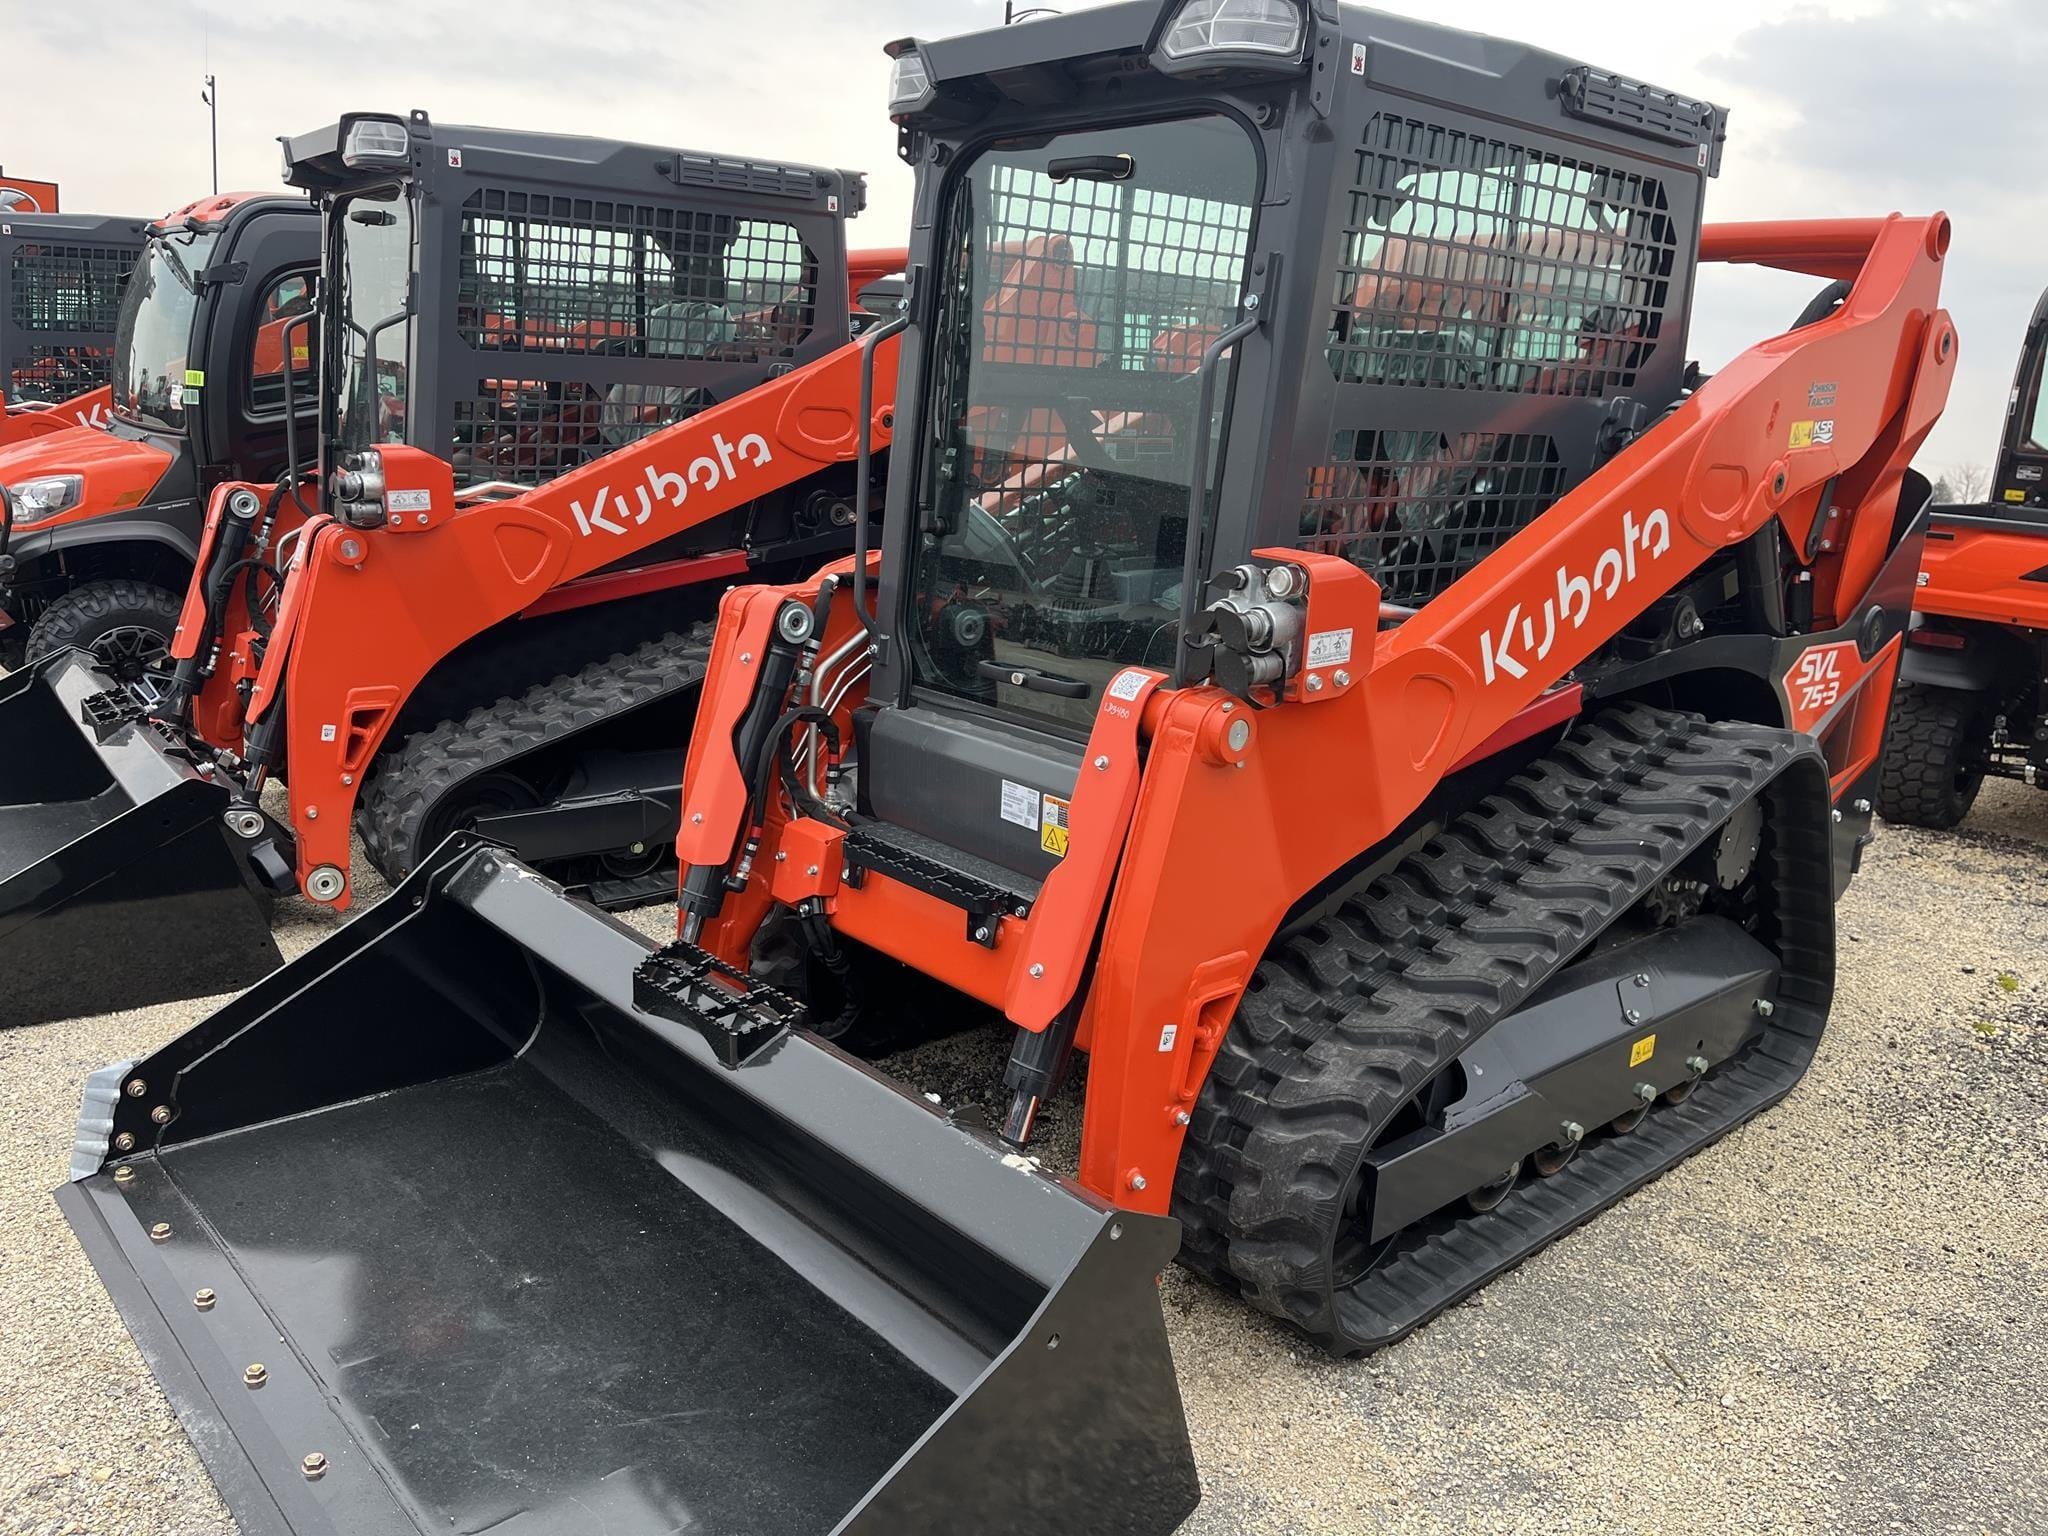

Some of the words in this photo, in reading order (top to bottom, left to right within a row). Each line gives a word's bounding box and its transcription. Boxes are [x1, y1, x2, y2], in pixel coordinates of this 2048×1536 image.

[570, 433, 772, 537] Kubota
[1480, 508, 1671, 686] Kubota
[1795, 650, 1841, 685] SVL
[1799, 681, 1840, 711] 75-3
